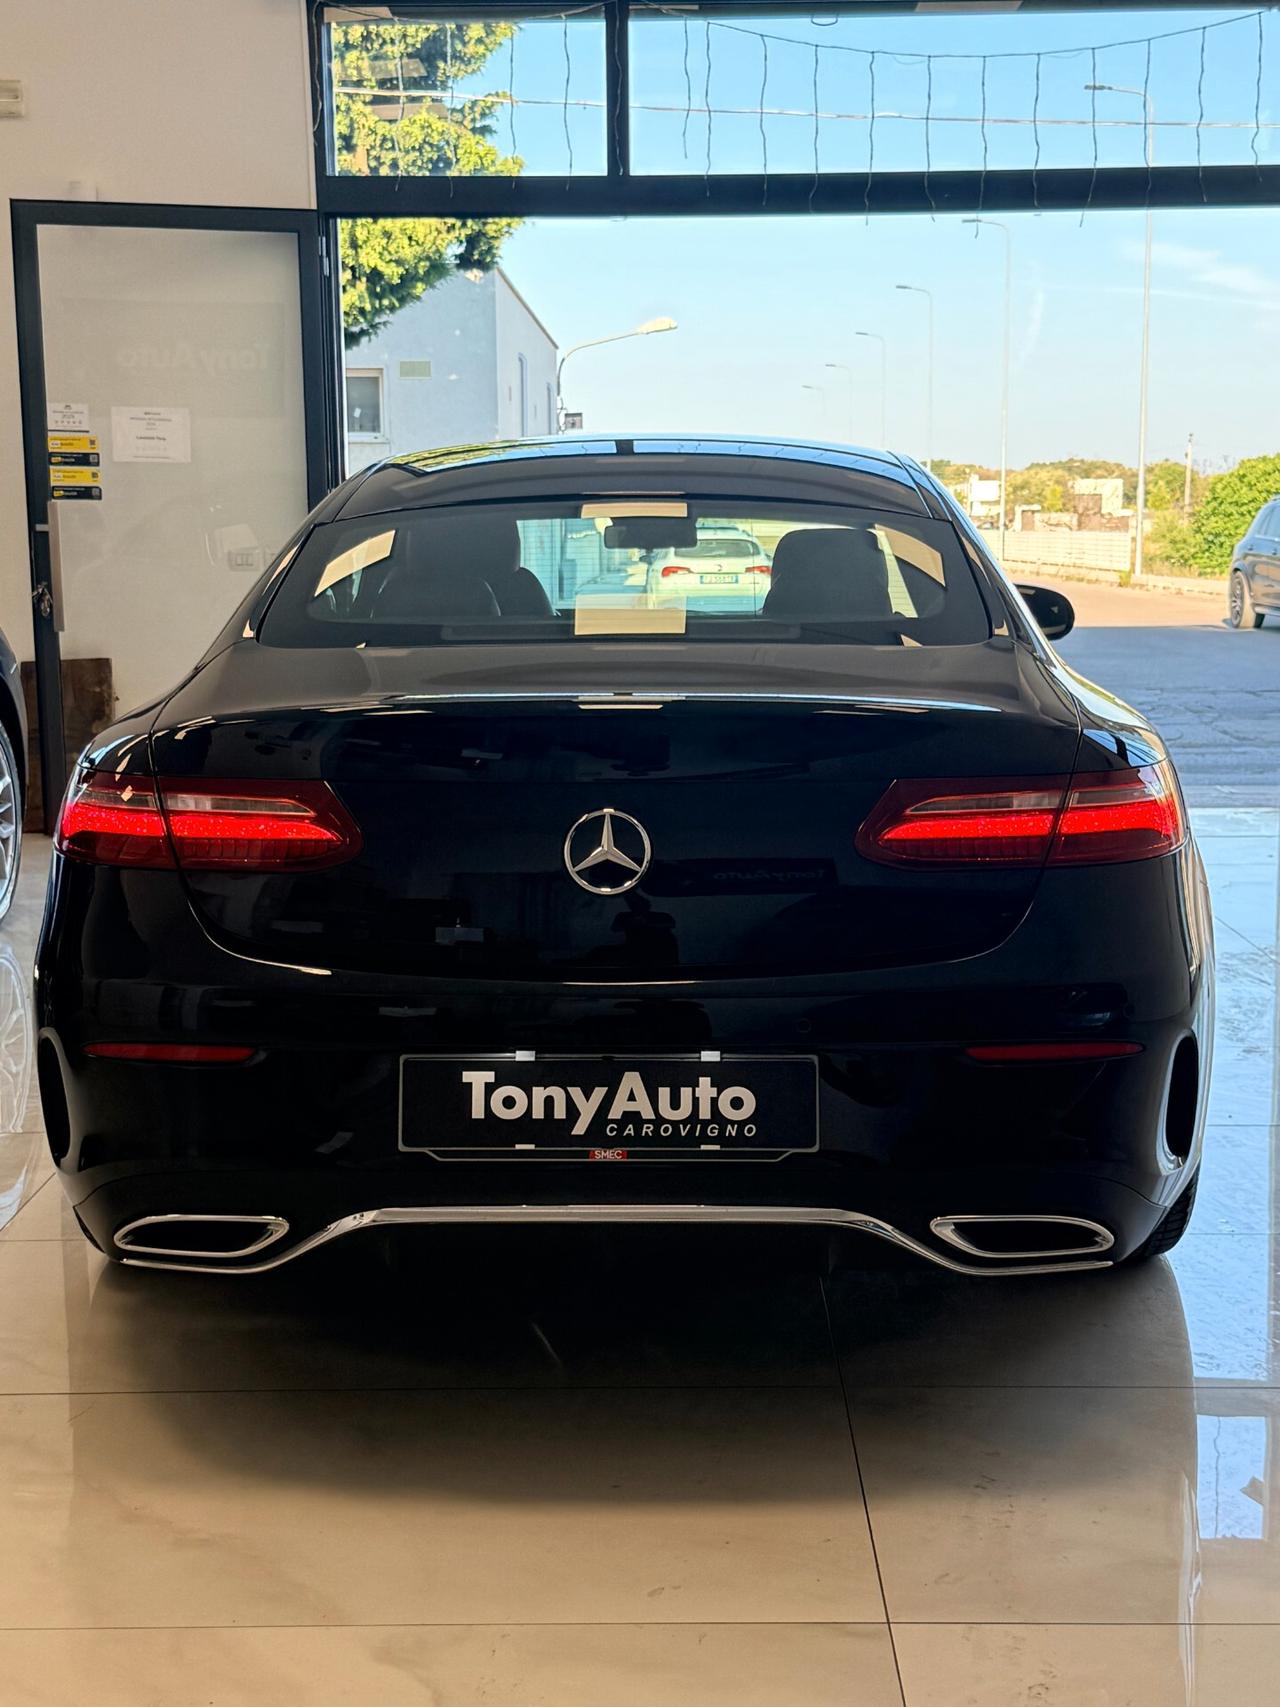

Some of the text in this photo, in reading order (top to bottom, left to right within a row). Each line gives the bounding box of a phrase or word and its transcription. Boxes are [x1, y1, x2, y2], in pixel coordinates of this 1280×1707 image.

[462, 1071, 757, 1136] TonyAuto
[606, 1123, 757, 1137] CAROVIGNO
[594, 1149, 623, 1160] SMEC
